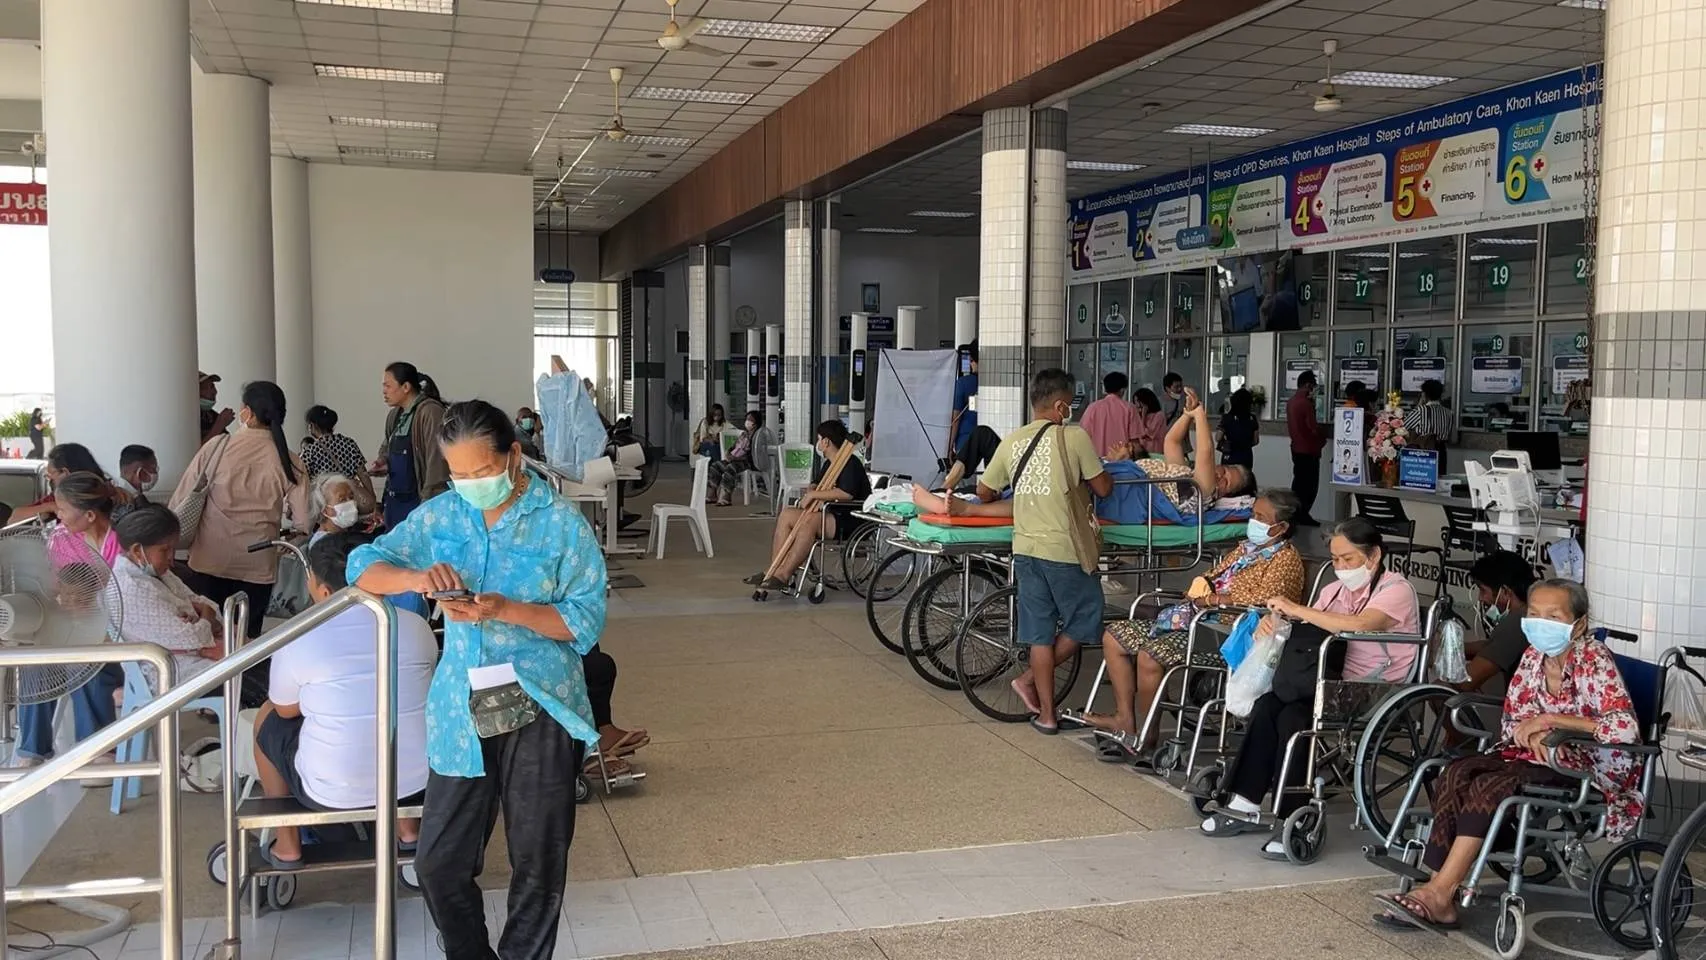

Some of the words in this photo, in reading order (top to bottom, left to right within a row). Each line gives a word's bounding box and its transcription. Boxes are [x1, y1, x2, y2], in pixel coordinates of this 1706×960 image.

[1376, 129, 1401, 143] Steps
[1404, 122, 1414, 136] of
[1416, 110, 1473, 134] Ambulatory
[1476, 104, 1503, 119] Care,
[1505, 97, 1532, 113] Khon
[1535, 89, 1561, 105] Kaen
[1512, 138, 1539, 152] Station
[1213, 169, 1231, 181] Steps
[1233, 165, 1241, 176] of
[1241, 160, 1258, 174] OPD
[1292, 149, 1311, 162] Khon
[1314, 144, 1334, 157] Kaen
[1336, 133, 1370, 151] Hospital
[1400, 162, 1424, 175] Station
[1505, 155, 1527, 201] 6
[1552, 174, 1573, 185] Home
[1296, 184, 1318, 195] Station
[1397, 176, 1416, 217] 5
[1295, 196, 1310, 232] 4
[1350, 200, 1383, 213] Examination
[1136, 229, 1144, 257] 2
[1073, 241, 1080, 267] 1
[1419, 273, 1434, 292] 18
[1492, 265, 1508, 285] 19
[1355, 280, 1368, 297] 17
[1145, 300, 1154, 314] 13
[1183, 296, 1192, 311] 14
[1356, 342, 1364, 353] 17
[1419, 340, 1428, 352] 18
[1492, 338, 1502, 350] 19
[1345, 420, 1351, 433] 2
